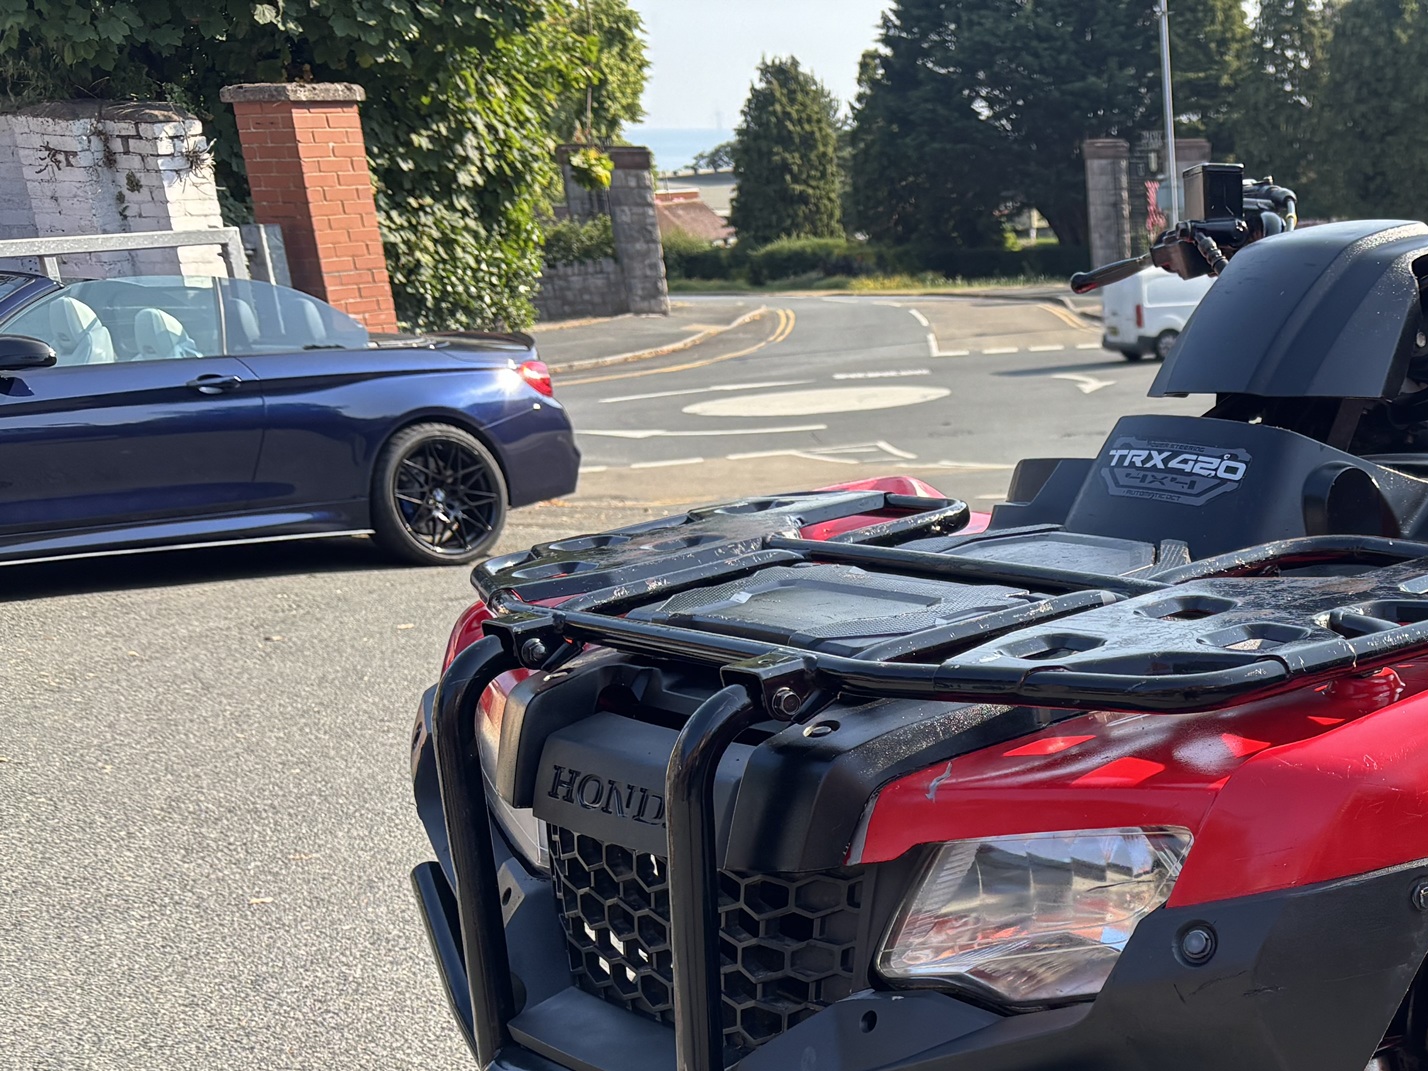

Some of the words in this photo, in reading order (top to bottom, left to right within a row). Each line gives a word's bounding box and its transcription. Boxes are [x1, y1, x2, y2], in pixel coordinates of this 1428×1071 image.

[1108, 449, 1247, 481] TRX420
[1125, 472, 1197, 490] 4X4
[548, 764, 667, 829] HOND
